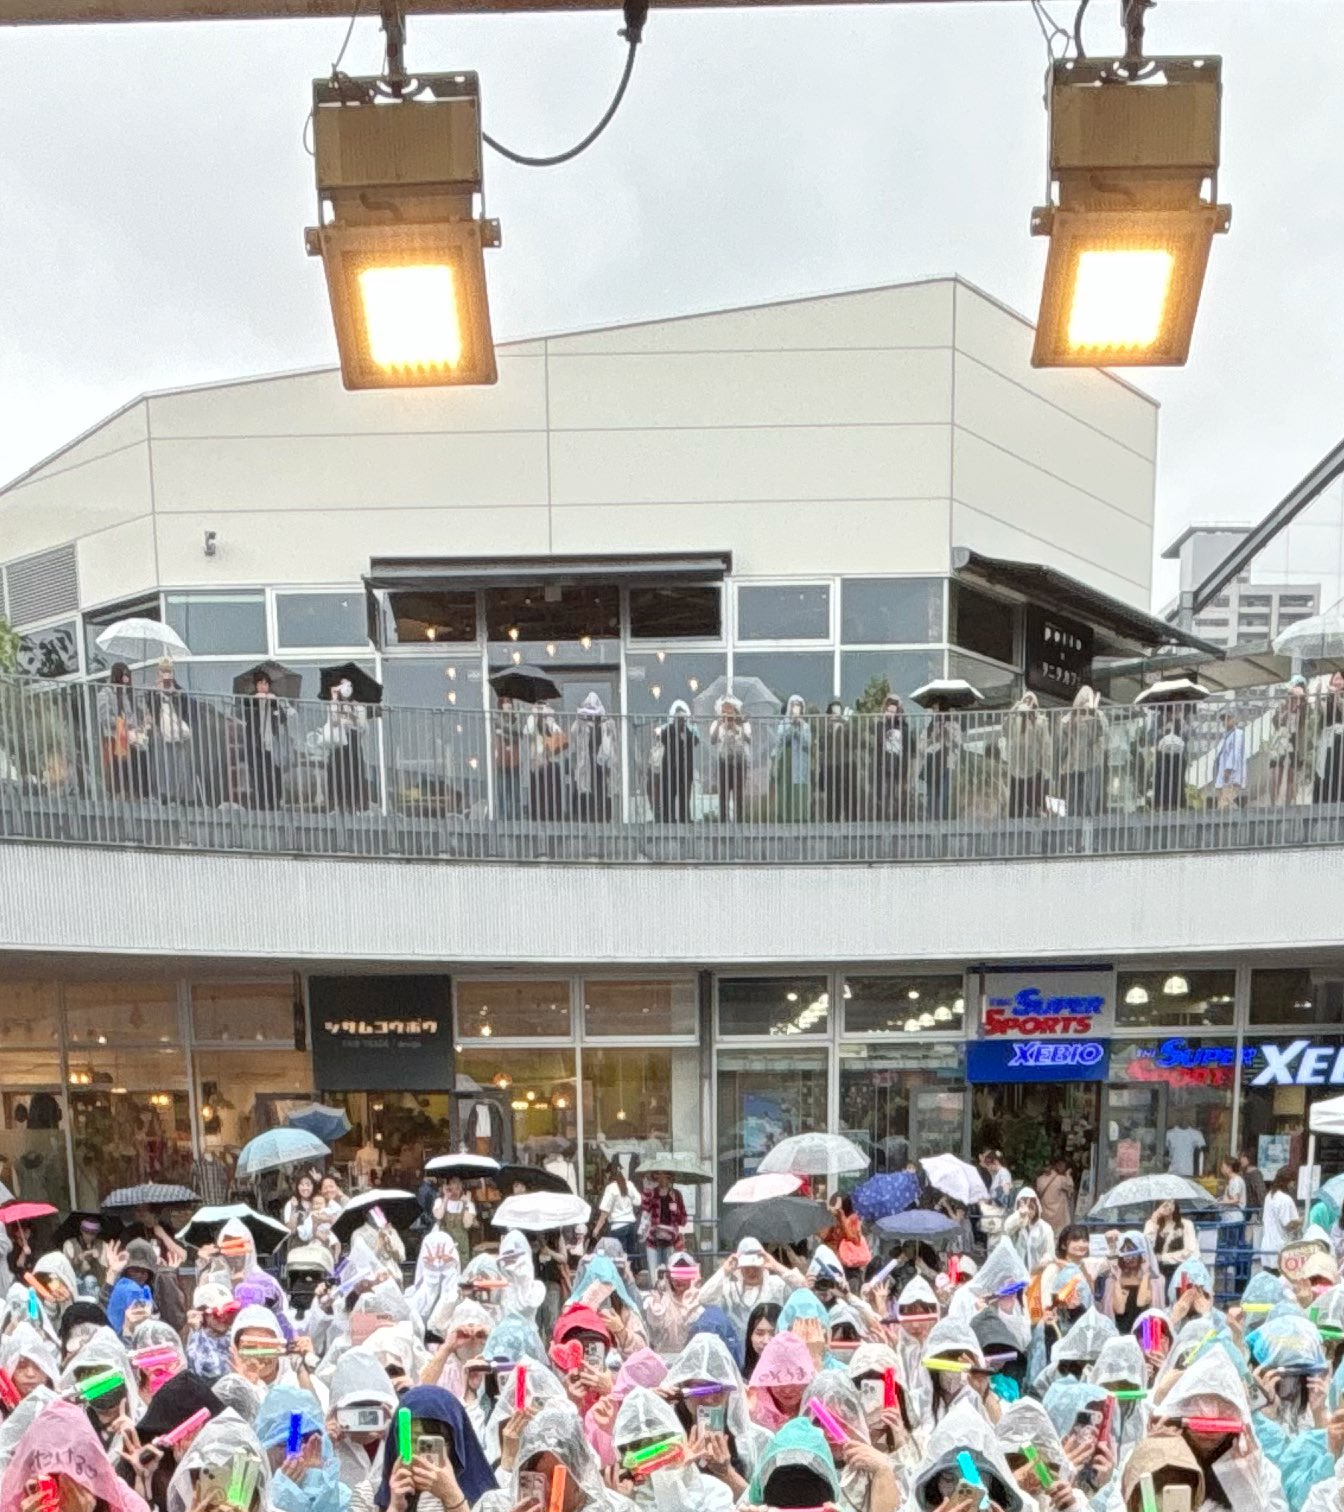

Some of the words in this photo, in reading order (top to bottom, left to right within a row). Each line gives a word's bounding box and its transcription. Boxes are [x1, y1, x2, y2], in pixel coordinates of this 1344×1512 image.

[1011, 986, 1105, 1016] SUPER
[985, 1008, 1093, 1036] SPORTS
[1008, 1041, 1104, 1066] XEBIO
